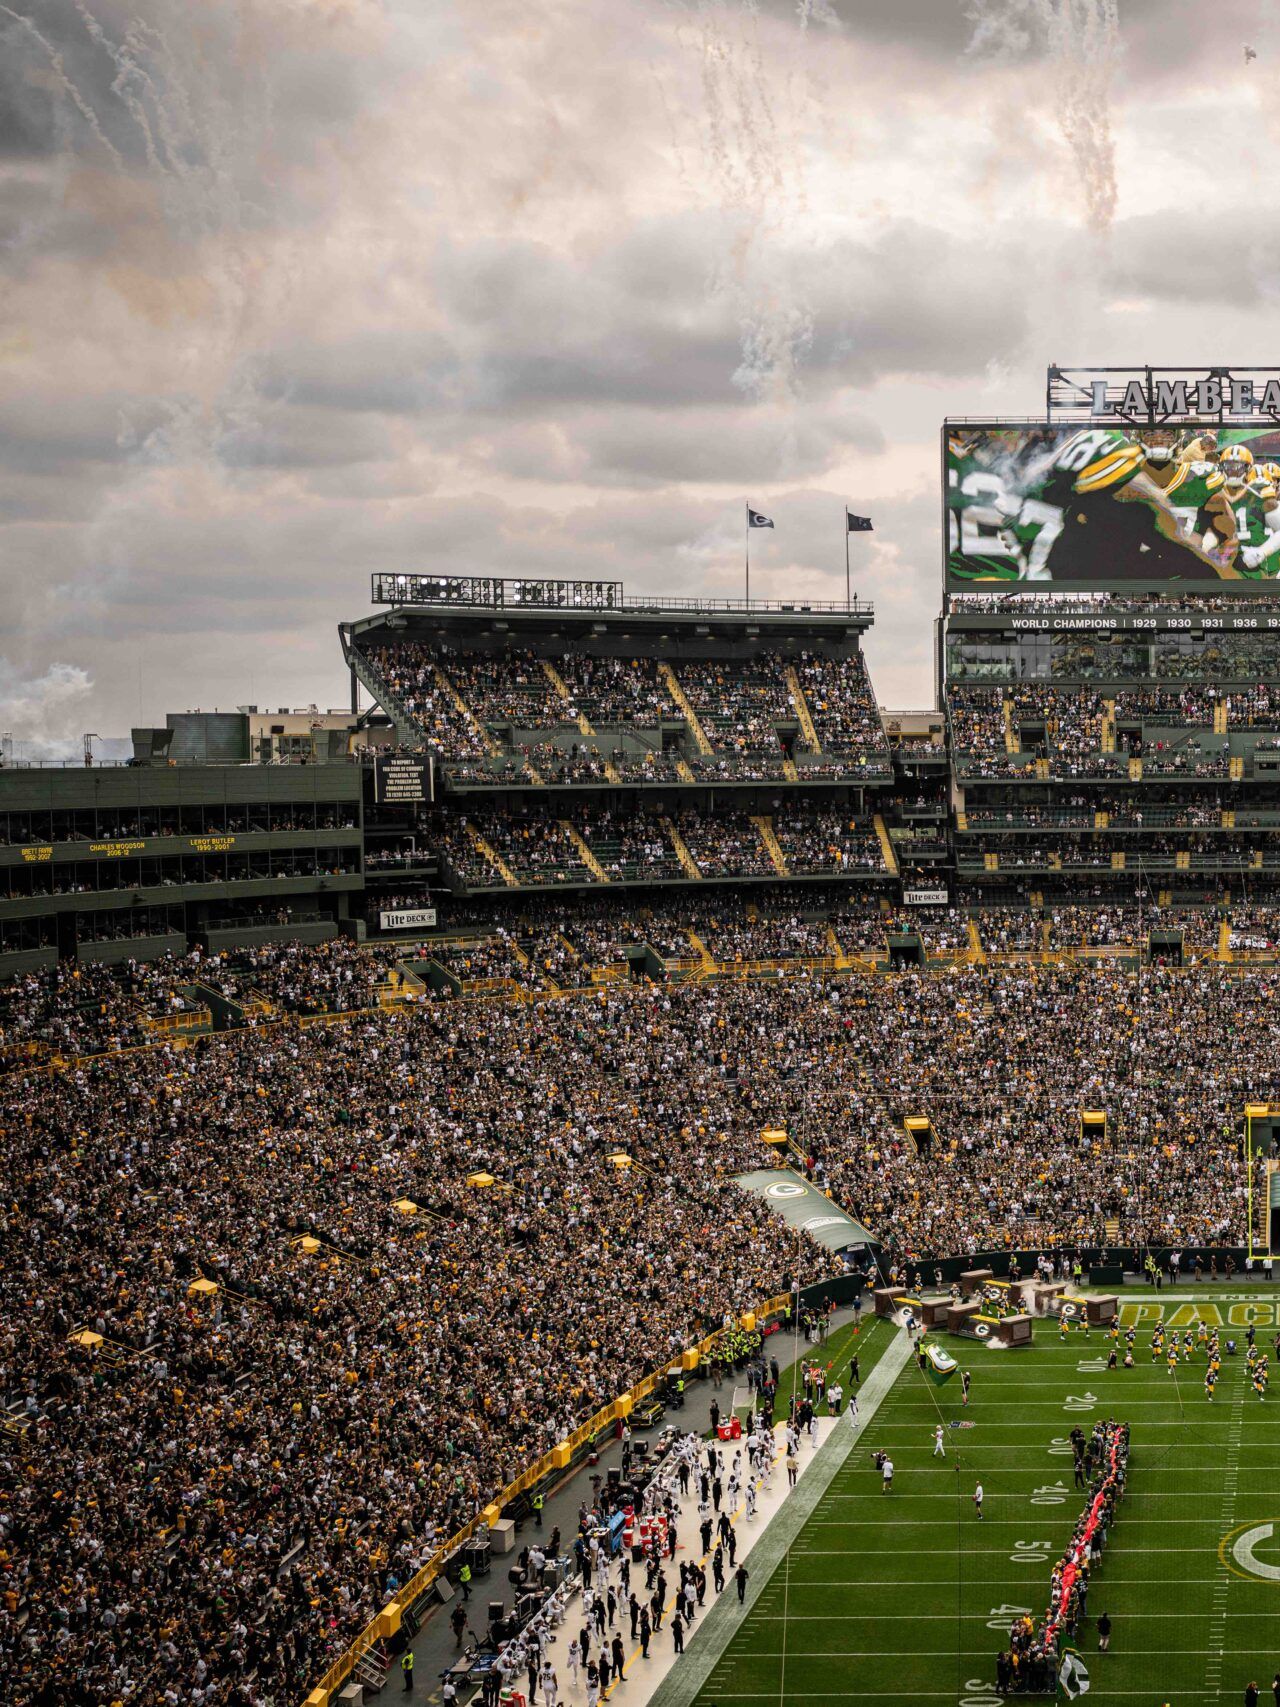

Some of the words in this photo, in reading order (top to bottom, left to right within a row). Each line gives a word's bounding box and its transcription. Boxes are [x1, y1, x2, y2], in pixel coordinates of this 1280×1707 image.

[1012, 619, 1049, 628] WORLD
[1053, 619, 1117, 628] CHAMPIONS
[1132, 619, 1157, 628] 1929
[1166, 619, 1192, 628] 1930
[1201, 618, 1224, 628] 1931
[1233, 618, 1258, 628] 1936
[1009, 1540, 1052, 1562] 50
